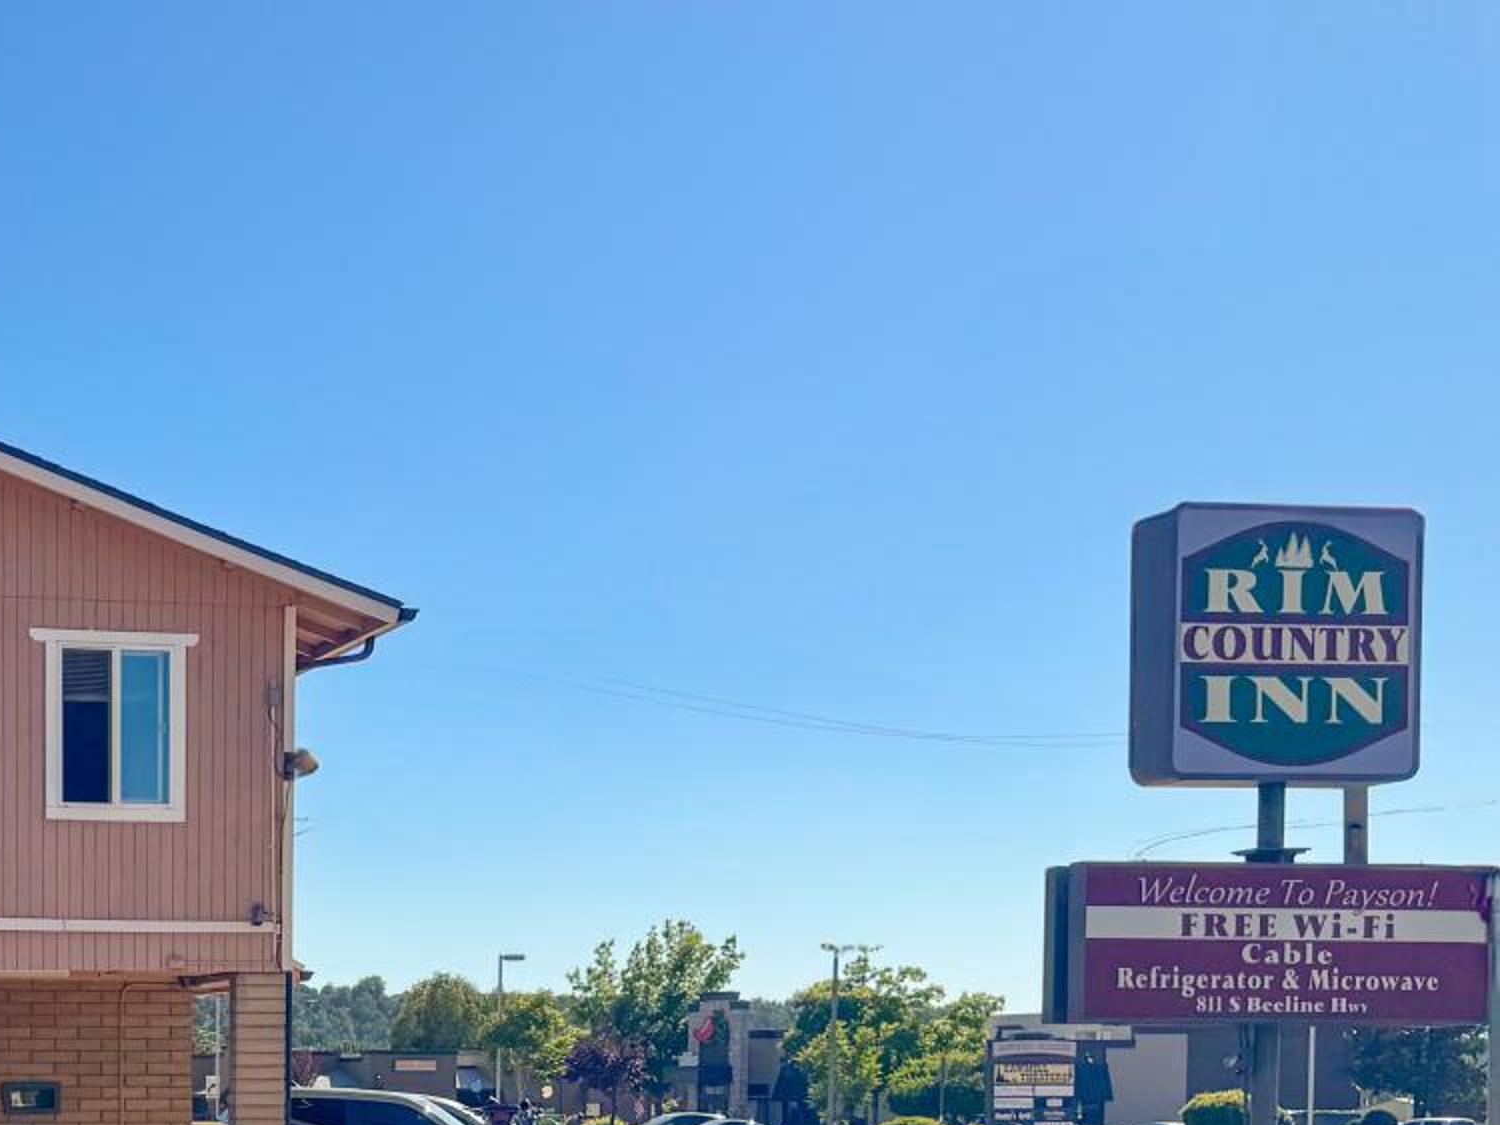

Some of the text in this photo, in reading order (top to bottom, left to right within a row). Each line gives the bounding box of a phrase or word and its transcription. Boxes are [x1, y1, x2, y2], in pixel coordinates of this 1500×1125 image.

[1203, 568, 1389, 615] RIM
[1183, 625, 1406, 662] COUNTRY
[1199, 675, 1389, 724] INN
[1138, 872, 1439, 916] Welcome To Payson!
[1181, 912, 1395, 938] FREE Wi-Fi
[1241, 943, 1333, 965] Cable
[1116, 965, 1439, 997] Refrigerator & Microwave
[1196, 995, 1222, 1013] 811
[1228, 996, 1242, 1013] S
[1247, 995, 1325, 1013] Beeline
